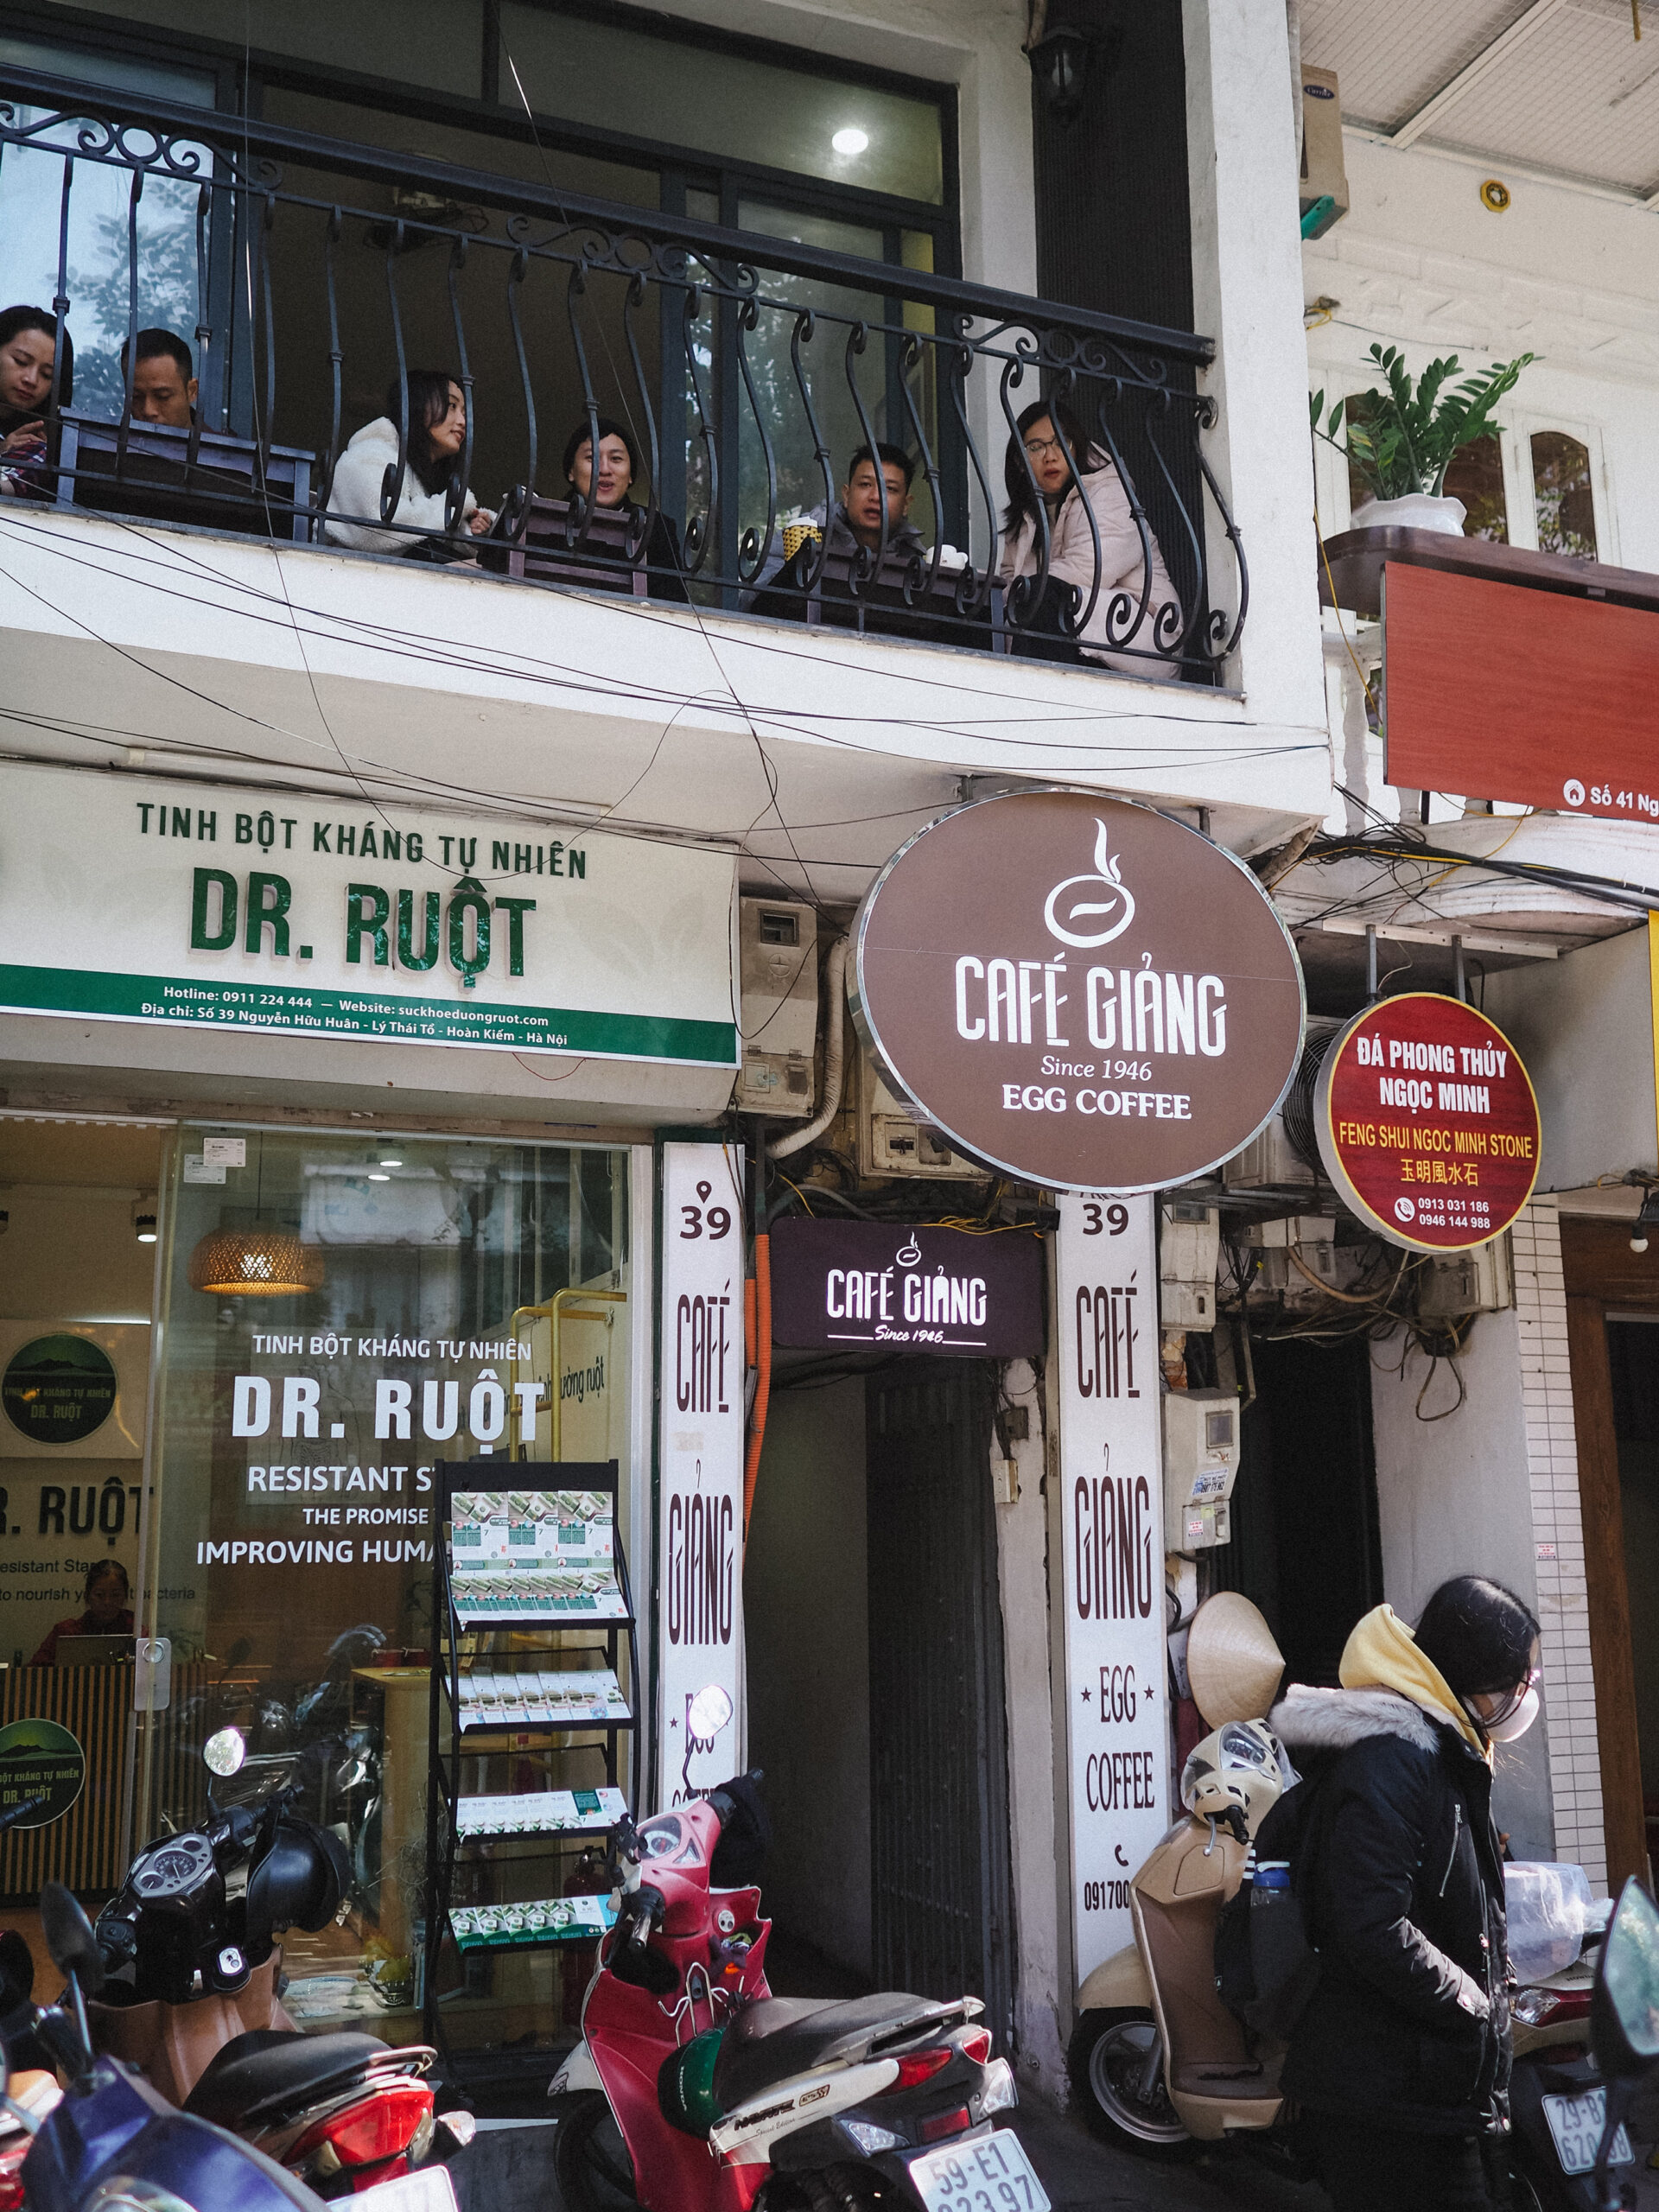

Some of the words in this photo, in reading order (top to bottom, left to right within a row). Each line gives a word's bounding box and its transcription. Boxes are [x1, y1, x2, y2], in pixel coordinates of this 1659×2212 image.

[1590, 784, 1612, 806] Số
[1616, 791, 1633, 809] 41
[137, 803, 216, 842] TINH
[235, 810, 297, 853] BỘT
[313, 821, 423, 862] KHÁNG
[439, 836, 477, 874] TỰ
[493, 841, 586, 879] NHIÊN
[189, 867, 313, 960] DR.
[346, 876, 537, 990] RUỘT
[164, 986, 219, 1001] Hotline:
[222, 991, 255, 1004] 0911
[259, 994, 284, 1007] 224
[288, 997, 313, 1008] 444
[340, 1000, 396, 1014] Website:
[398, 1005, 549, 1027] suckhoeduongruot.com
[955, 951, 1070, 1047] CAFÉ
[1086, 951, 1228, 1057] GIẢNG
[141, 1002, 165, 1018] Địa
[168, 1004, 194, 1018] chỉ:
[197, 1006, 214, 1019] Số
[218, 1009, 235, 1020] 39
[238, 1011, 290, 1027] Nguyễn
[294, 1014, 321, 1027] Hữu
[325, 1016, 359, 1029] Huân
[372, 1020, 387, 1034] Lý
[390, 1021, 417, 1034] Thái
[420, 1023, 435, 1035] Tổ
[446, 1026, 480, 1039] Hoàn
[483, 1027, 515, 1041] Kiếm
[526, 1031, 543, 1044] Hà
[546, 1033, 568, 1047] Nội
[1040, 1056, 1095, 1078] Since
[1102, 1059, 1153, 1082] 1946
[1357, 1033, 1384, 1066] ĐÁ
[1389, 1039, 1455, 1073] PHONG
[1459, 1040, 1507, 1078] THỦY
[1001, 1084, 1067, 1112] EGG
[1075, 1089, 1192, 1120] COFFEE
[1379, 1077, 1433, 1114] NGỌC
[1438, 1083, 1491, 1114] MINH
[1339, 1122, 1376, 1147] FENG
[1379, 1125, 1410, 1150] SHUI
[1414, 1128, 1452, 1152] NGOC
[1454, 1131, 1487, 1155] MINH
[1490, 1134, 1534, 1159] STONE
[1401, 1159, 1479, 1186] 玉明風水石
[679, 1205, 732, 1241] 39
[1082, 1203, 1129, 1236] 39
[1418, 1197, 1445, 1211] 0913
[1447, 1198, 1466, 1211] 031
[1470, 1200, 1489, 1213] 186
[1419, 1214, 1446, 1227] 0946
[1448, 1215, 1468, 1228] 144
[1471, 1216, 1491, 1230] 988
[827, 1265, 894, 1321] CAFÉ
[904, 1265, 988, 1326] GIẢNG
[252, 1334, 303, 1355] TINH
[309, 1332, 352, 1359] BỘT
[358, 1333, 430, 1358] KHÁNG
[436, 1340, 466, 1363] TỰ
[469, 1338, 531, 1361] NHIÊN
[677, 1277, 730, 1413] CAFÉ
[874, 1324, 910, 1342] Since
[912, 1330, 944, 1344] 1946
[1076, 1268, 1141, 1399] CAFÉ
[232, 1375, 345, 1439] DR.
[375, 1368, 545, 1455] RUỘT
[247, 1466, 409, 1492] RESISTANT
[39, 1477, 155, 1546] RUỘT
[302, 1508, 340, 1525] THE
[346, 1508, 429, 1525] PROMISE
[1074, 1442, 1153, 1621] GIẢNG
[197, 1541, 353, 1565] IMPROVING
[668, 1458, 734, 1646] GIẢNG
[16, 1587, 70, 1601] nourish
[1100, 1664, 1136, 1723] EGG
[1086, 1751, 1155, 1812] COFFEE
[928, 2141, 1010, 2196] 59-E1
